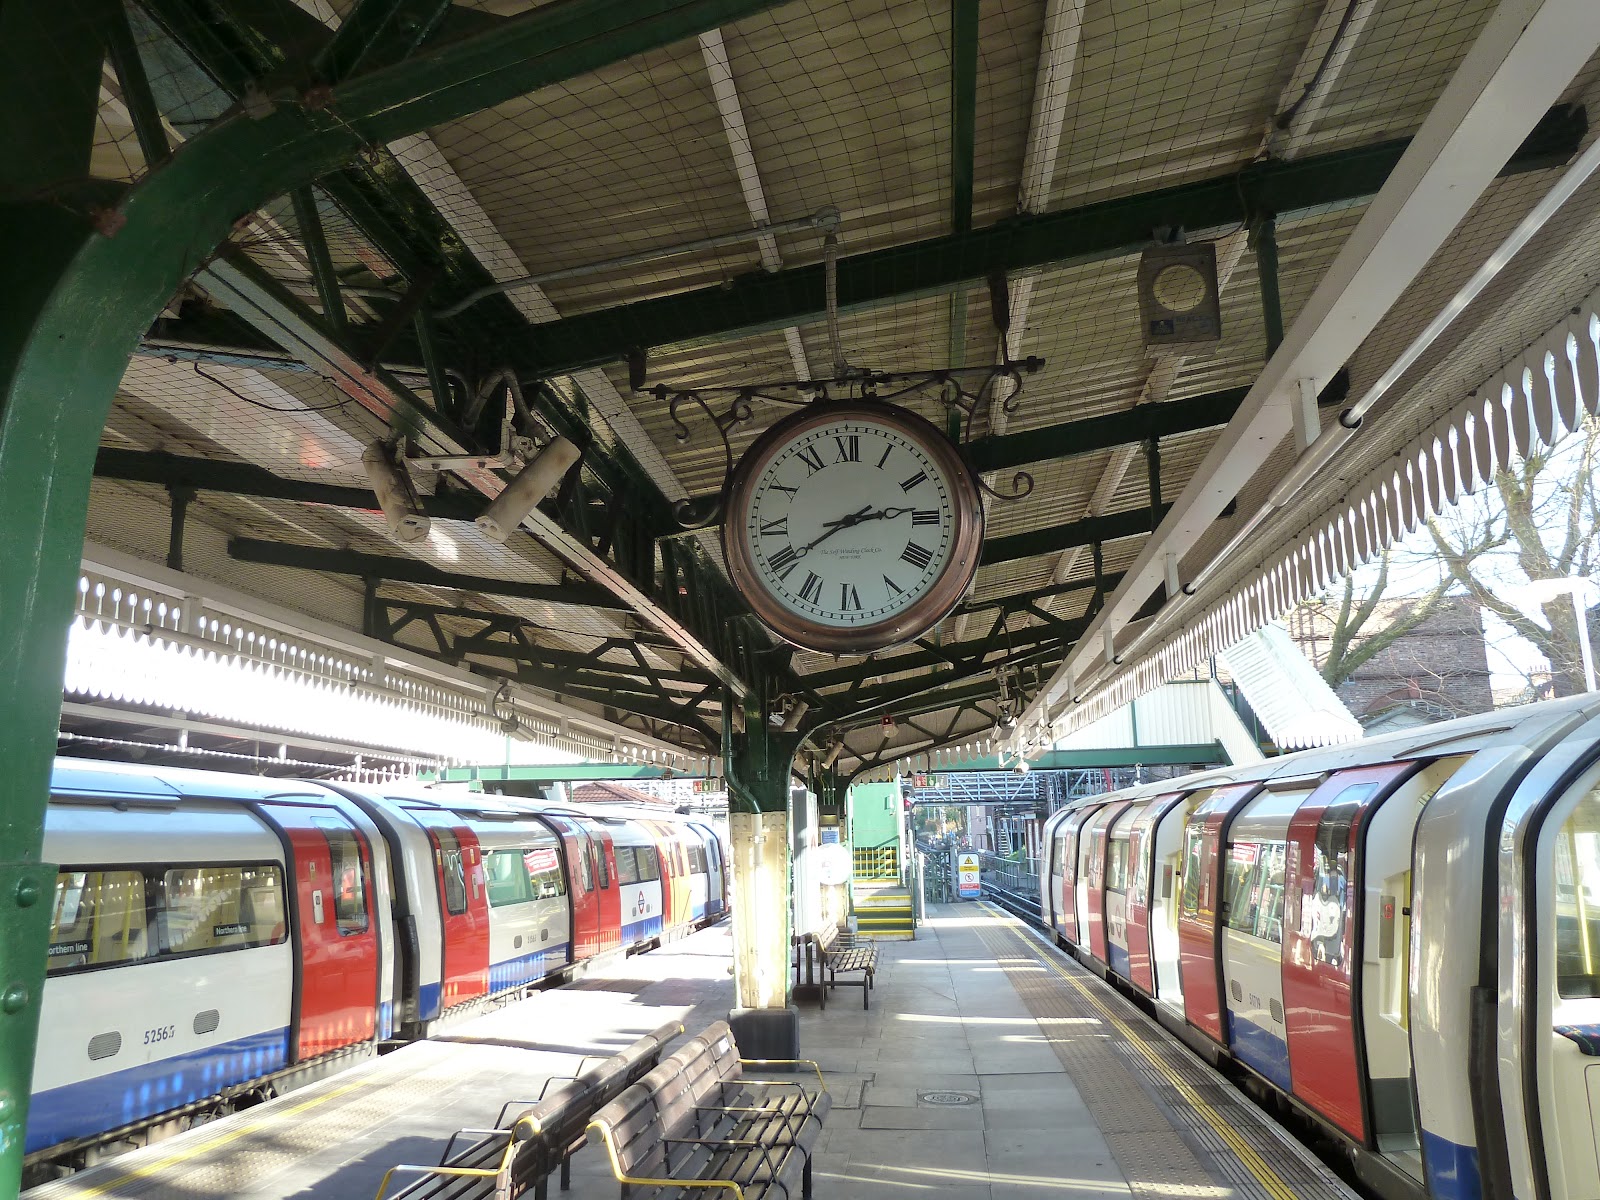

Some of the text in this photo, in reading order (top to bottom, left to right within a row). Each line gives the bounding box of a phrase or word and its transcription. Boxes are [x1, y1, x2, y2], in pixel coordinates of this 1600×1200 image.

[793, 444, 827, 478] XI
[833, 435, 862, 464] XII
[875, 443, 896, 470] I
[767, 475, 800, 503] X
[898, 468, 929, 494] II
[760, 513, 788, 539] IX
[911, 508, 940, 528] III
[766, 542, 800, 583] VIII
[797, 569, 824, 606] VII
[840, 583, 865, 611] VI
[883, 574, 906, 601] V
[215, 926, 238, 935] Northern
[48, 942, 88, 955] orthern line
[143, 1024, 175, 1045] 52565
